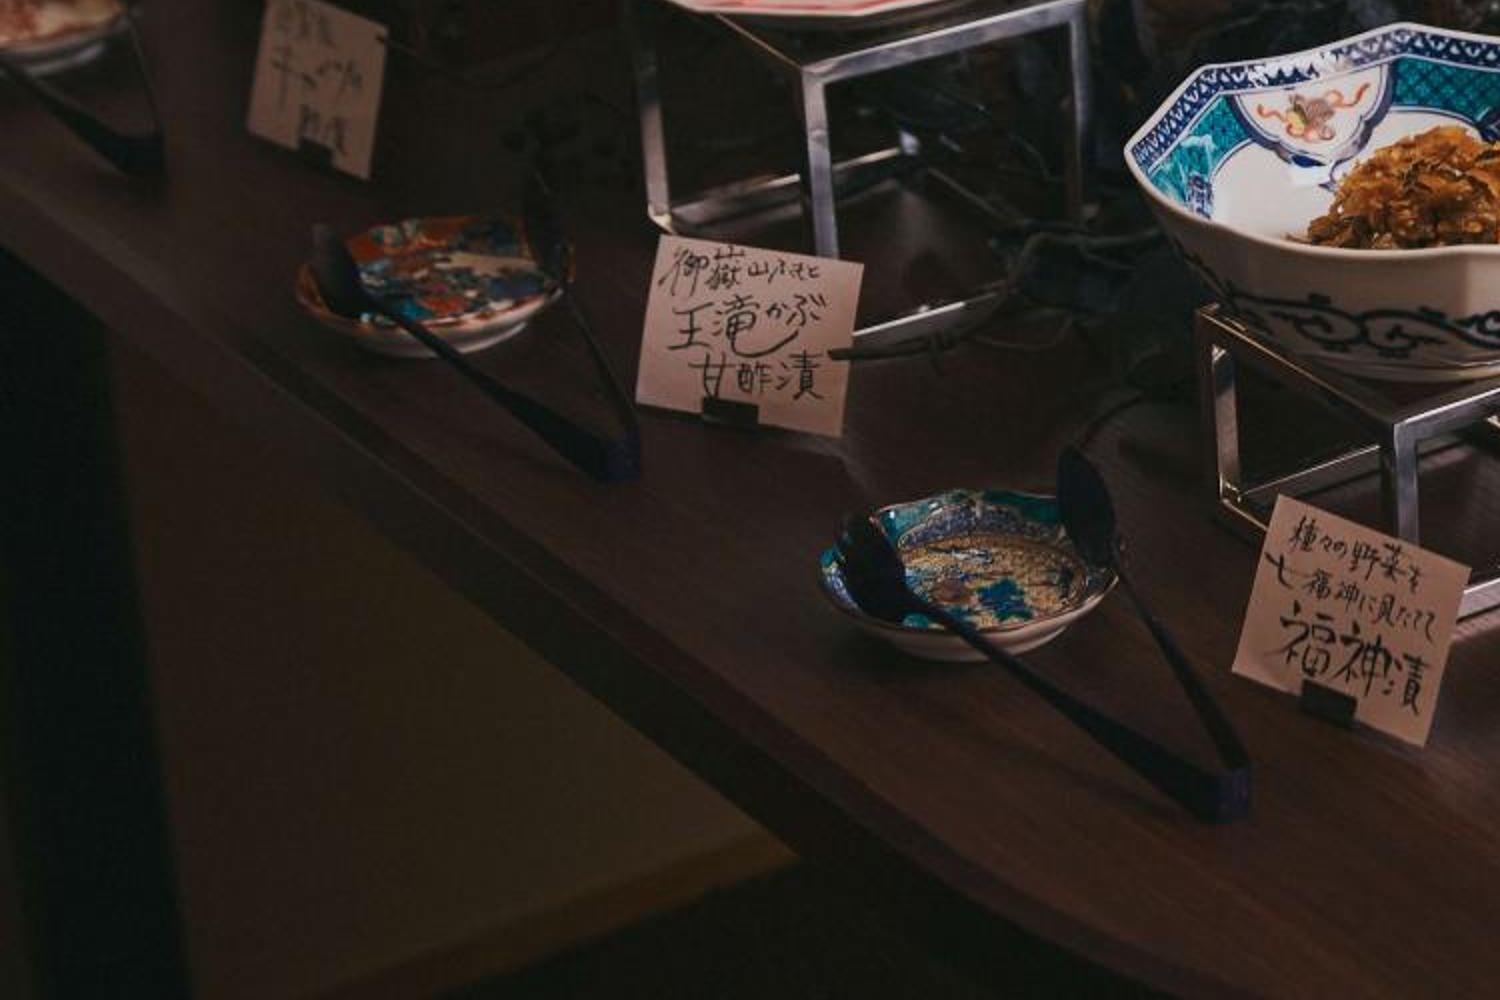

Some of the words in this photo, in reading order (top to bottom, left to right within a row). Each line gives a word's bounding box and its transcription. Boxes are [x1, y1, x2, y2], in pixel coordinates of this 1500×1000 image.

[668, 294, 826, 358] 王滝かぶ
[688, 349, 824, 400] 甘酢漬
[1288, 516, 1423, 594] 種々の野菜を
[1280, 600, 1429, 716] 福神漬
